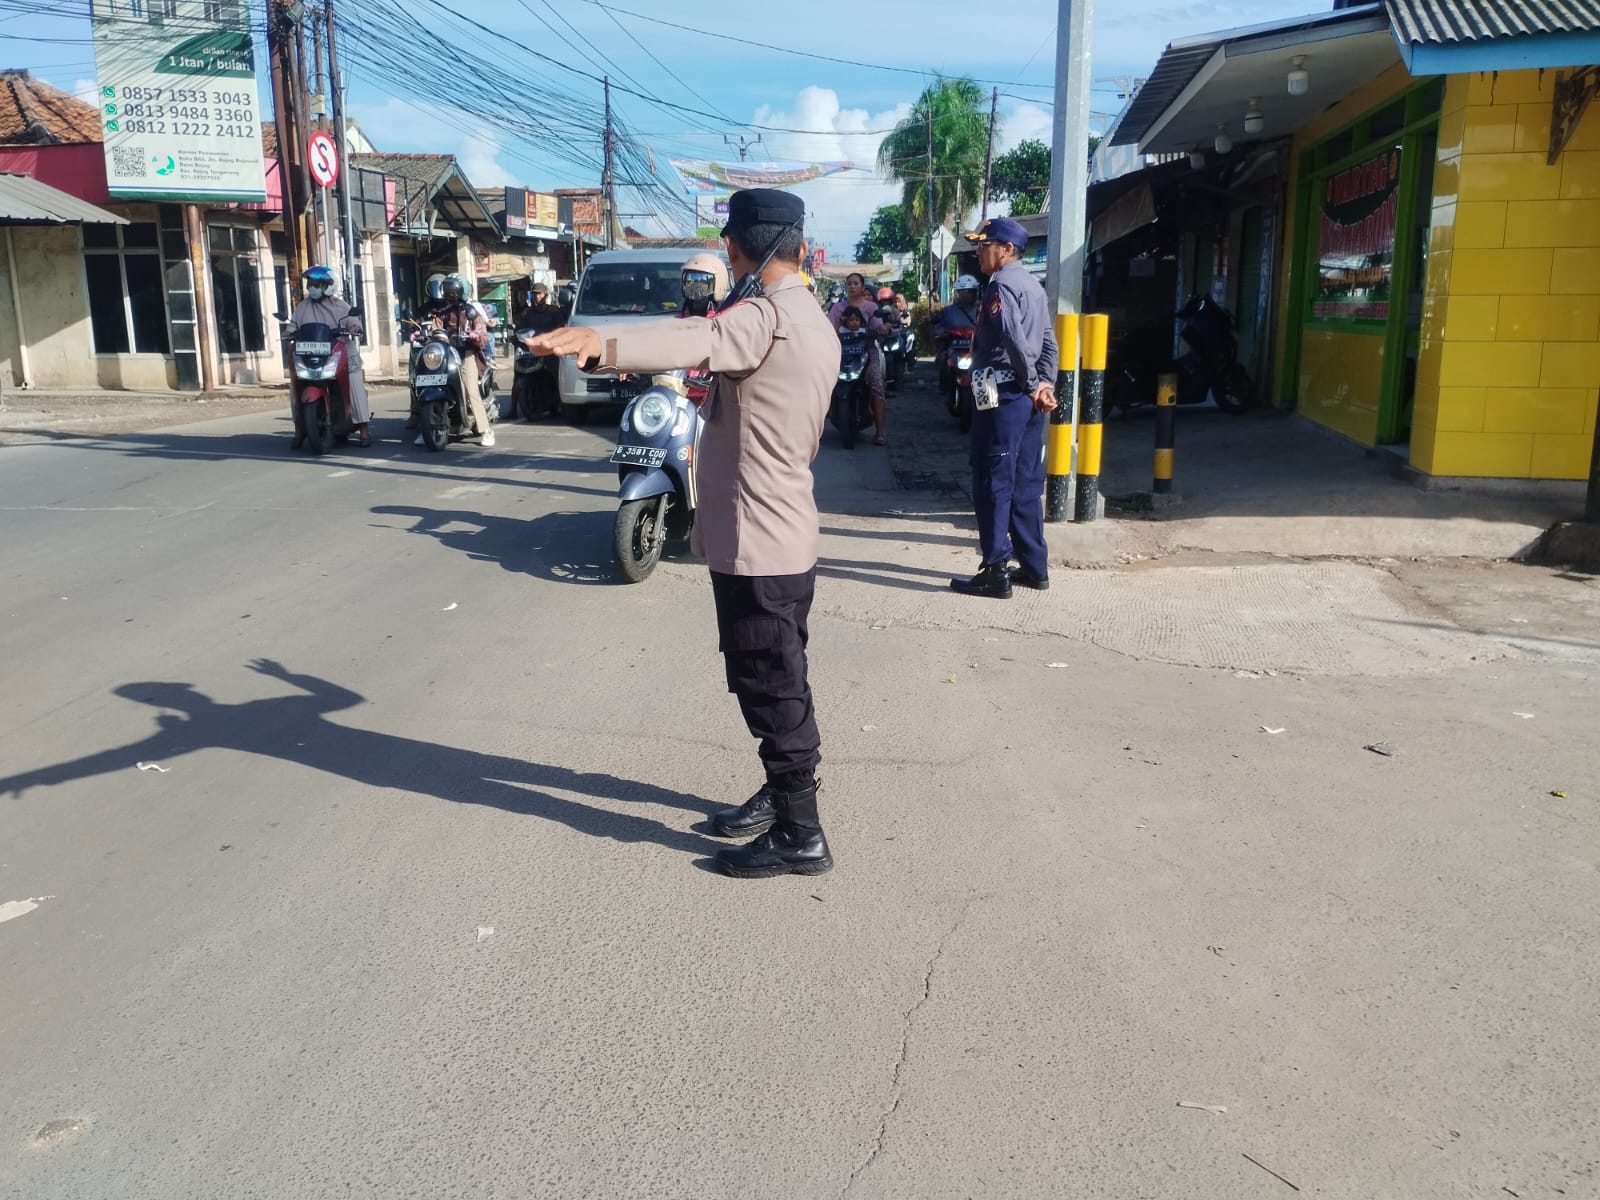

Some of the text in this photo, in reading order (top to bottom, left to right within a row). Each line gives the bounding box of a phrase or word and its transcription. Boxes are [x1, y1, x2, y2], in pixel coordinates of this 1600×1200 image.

[169, 56, 250, 71] 1 Jtan / bulan
[122, 86, 251, 106] 0857 1533 3043
[124, 103, 253, 122] 0813 9484 3360
[126, 120, 255, 138] 0812 1222 2412
[318, 142, 329, 173] S
[616, 446, 623, 454] B
[648, 449, 665, 458] COU
